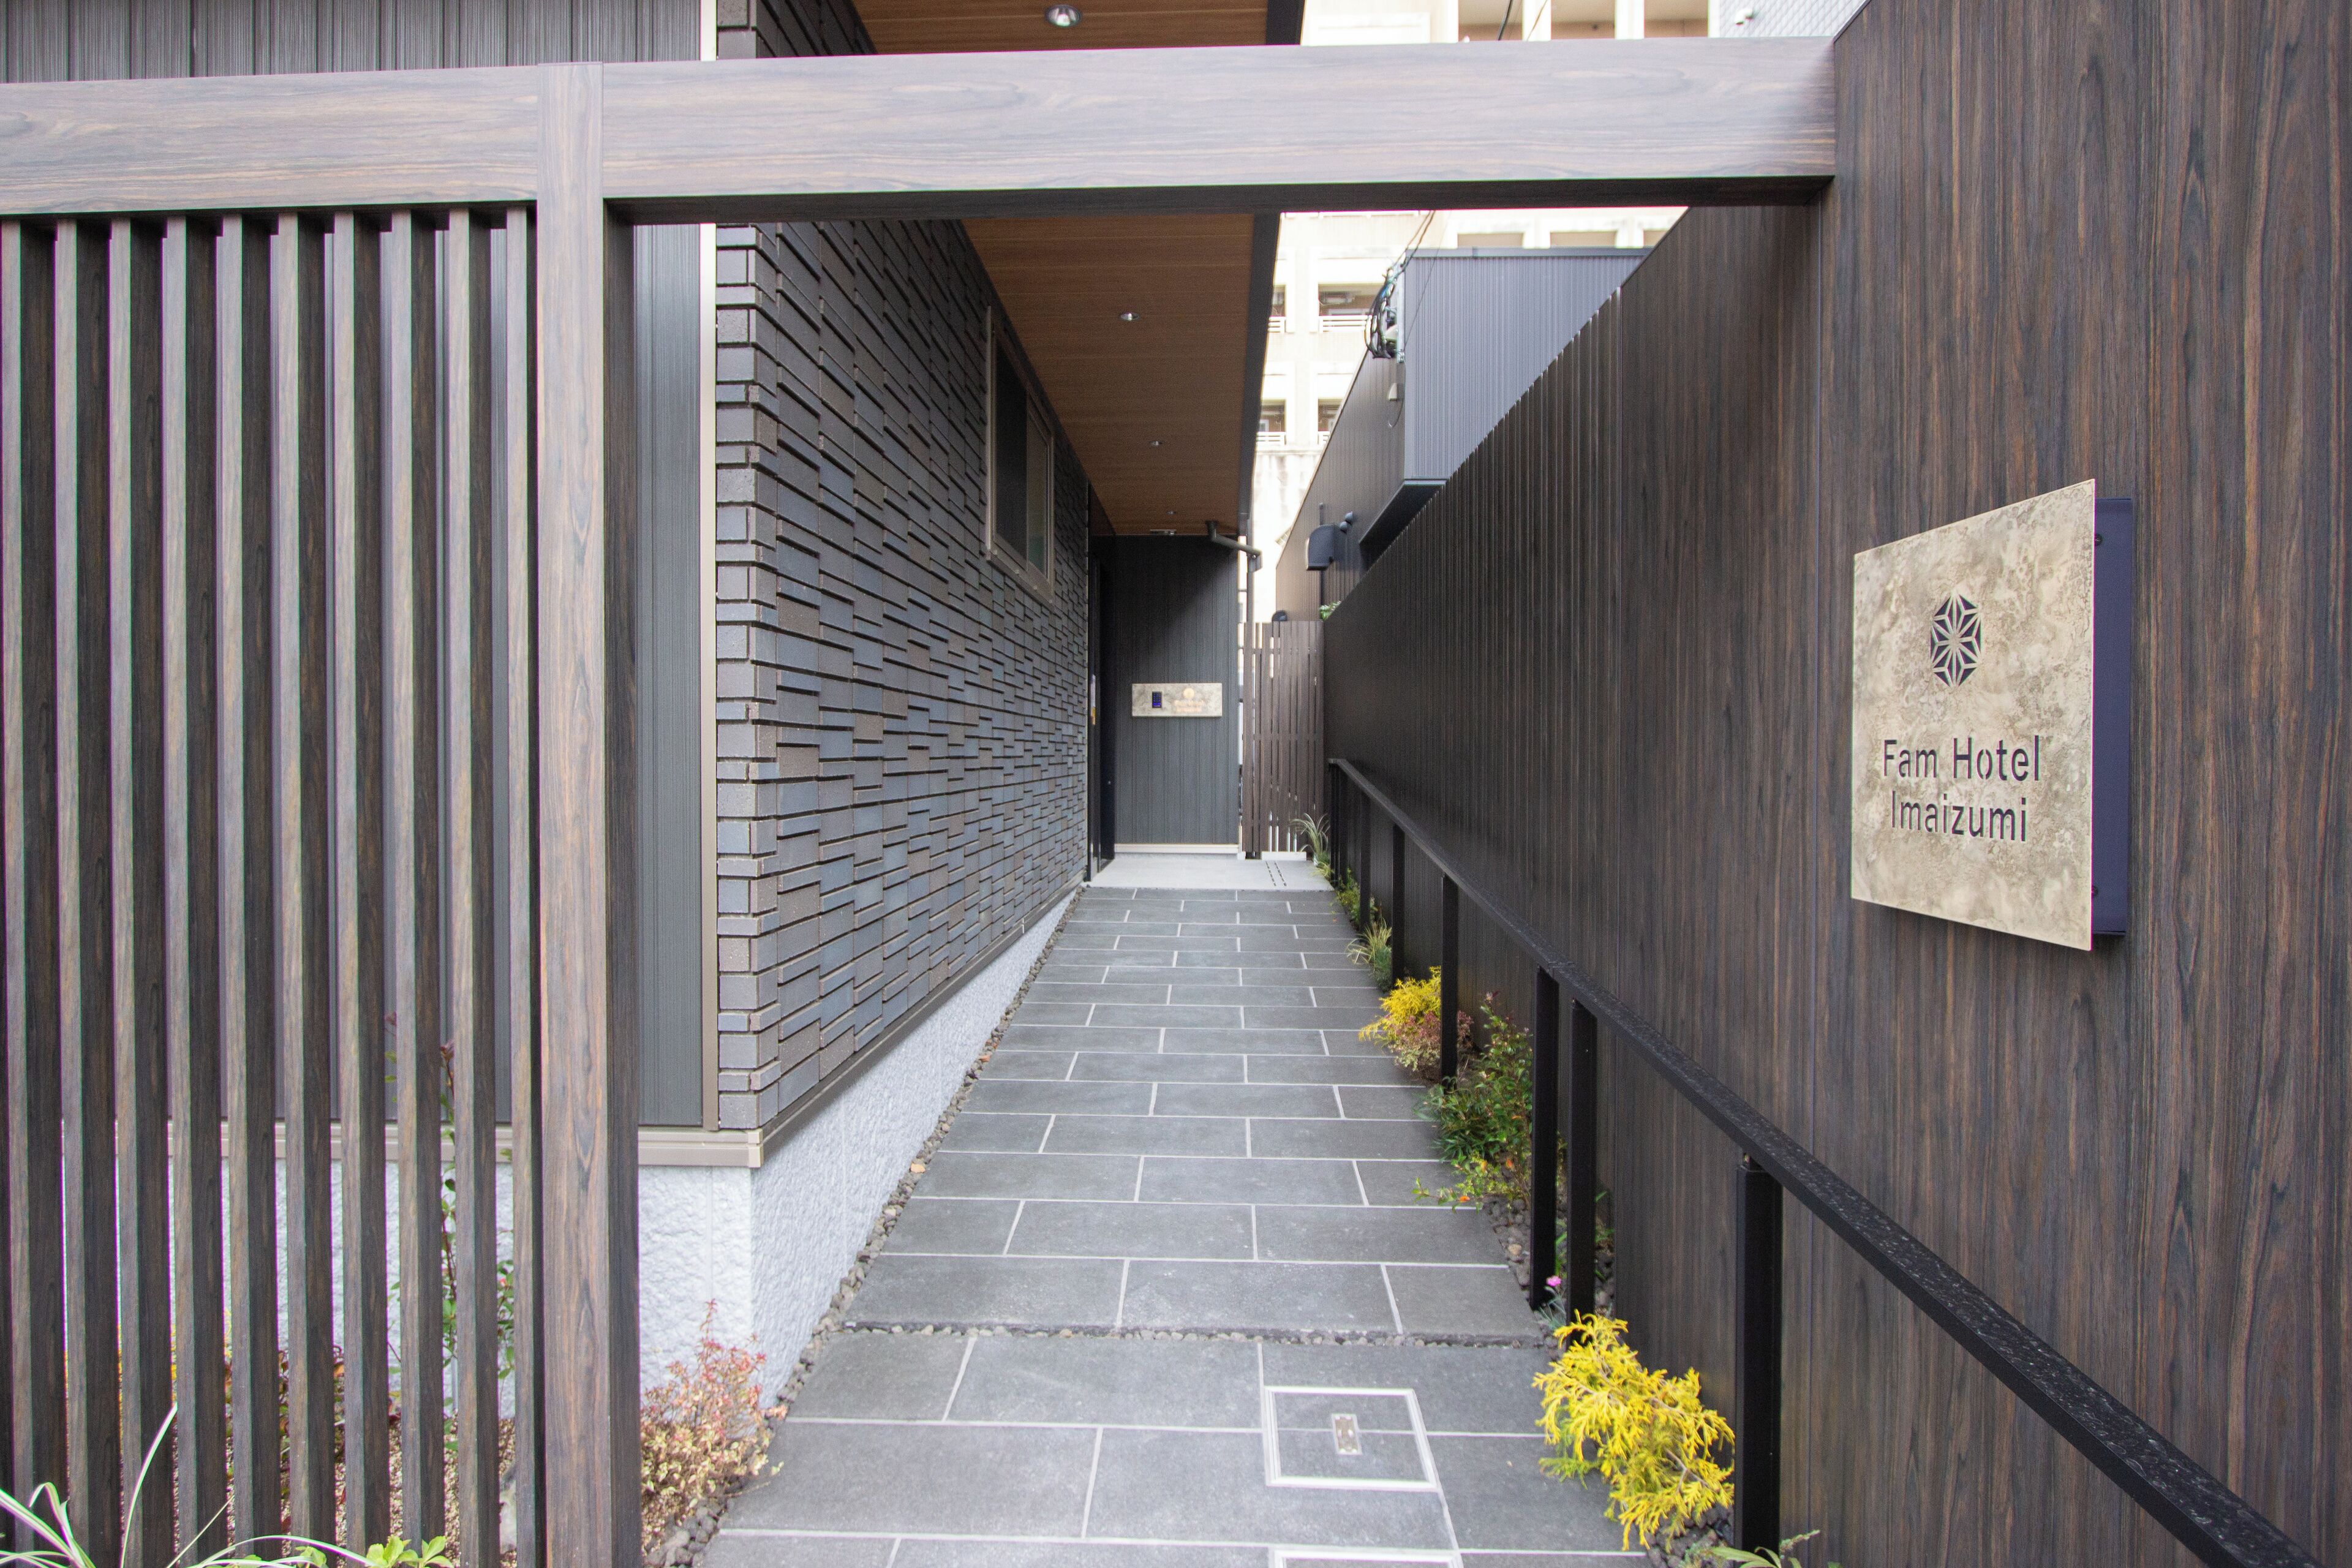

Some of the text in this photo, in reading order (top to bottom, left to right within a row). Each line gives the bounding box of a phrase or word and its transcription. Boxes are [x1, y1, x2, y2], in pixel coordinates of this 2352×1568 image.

[1883, 734, 2040, 782] Fam Hotel
[1891, 790, 2026, 842] Imaizumi
